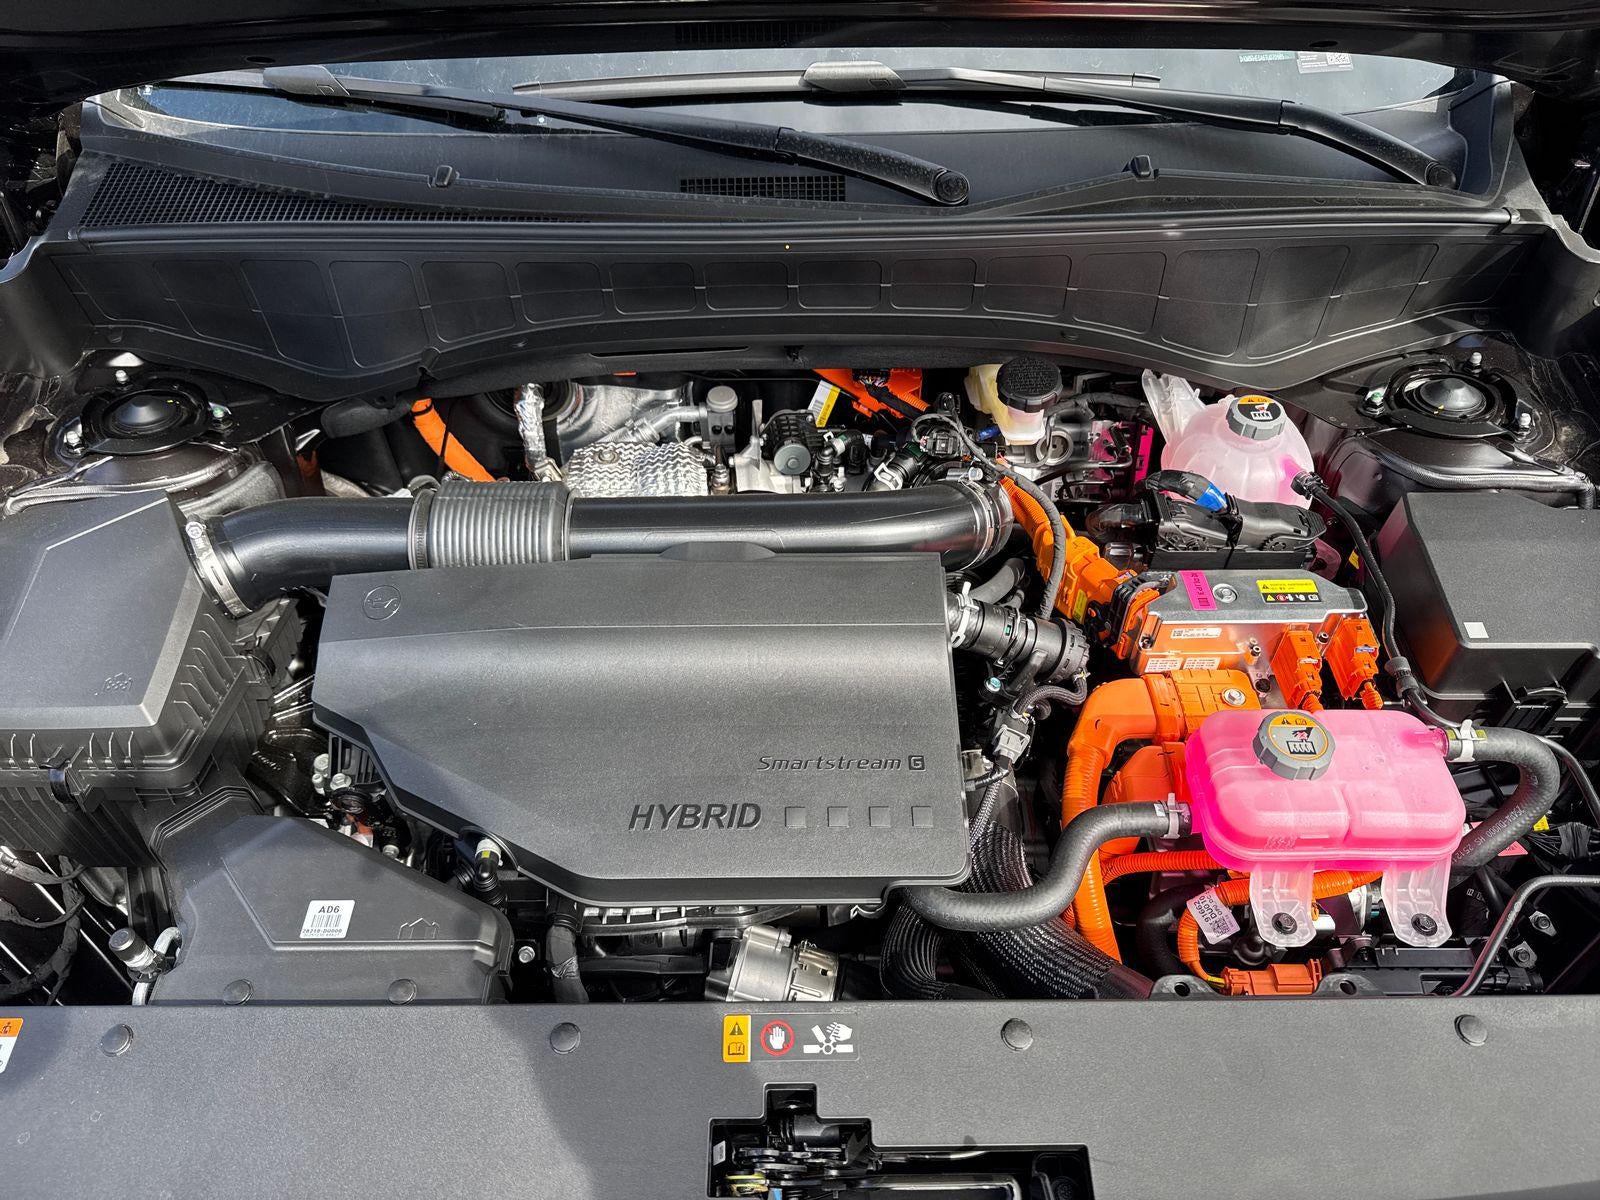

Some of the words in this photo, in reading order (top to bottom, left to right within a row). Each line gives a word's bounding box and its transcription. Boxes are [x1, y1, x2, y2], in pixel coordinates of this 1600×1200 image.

[757, 755, 901, 771] Smartstream
[908, 755, 926, 771] G
[628, 802, 763, 831] HYBRID
[318, 905, 340, 914] AD6
[1194, 900, 1212, 923] 91662
[1199, 895, 1218, 919] DU010
